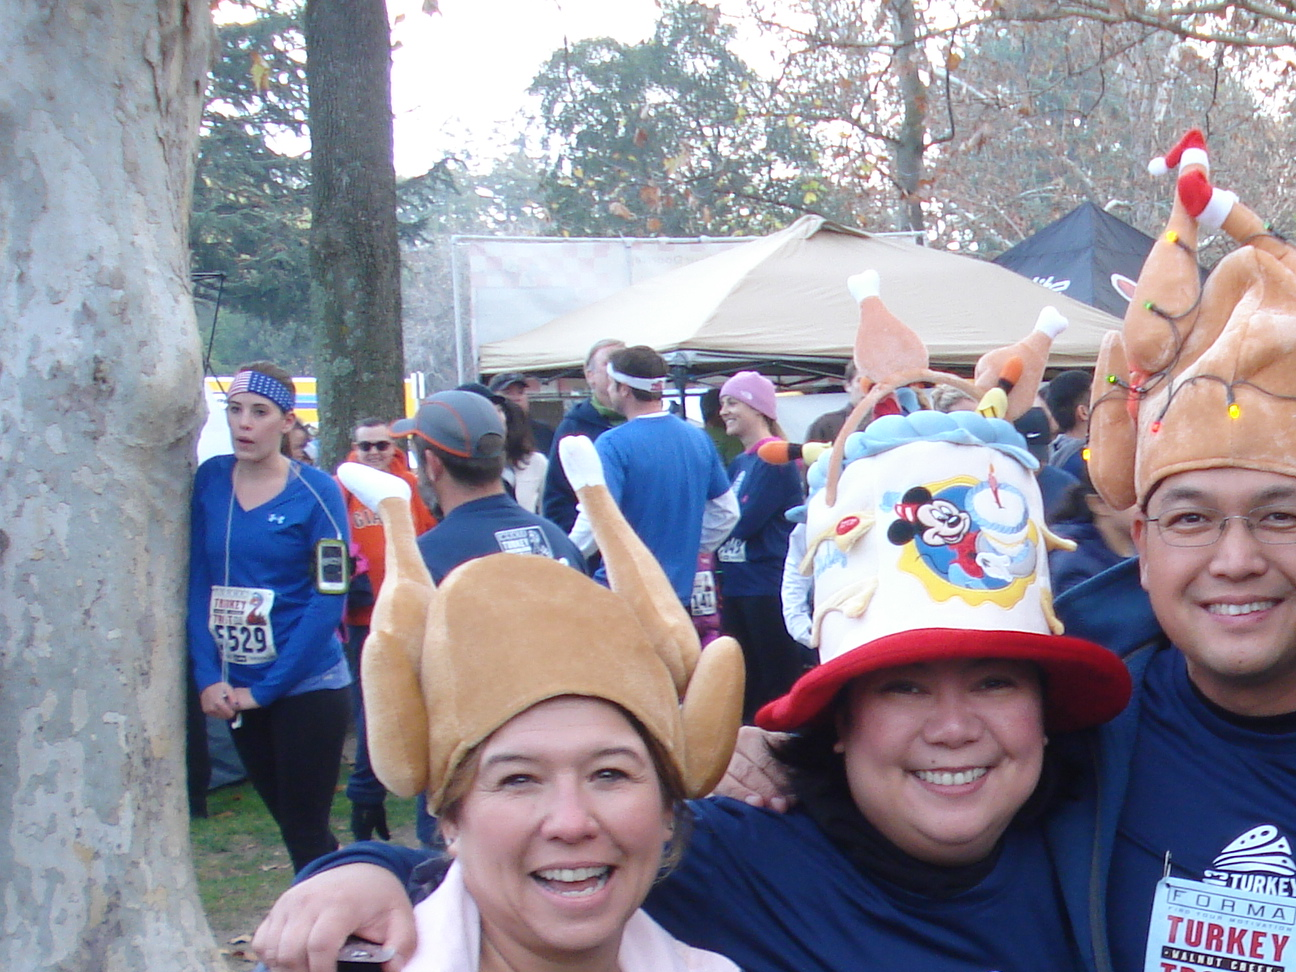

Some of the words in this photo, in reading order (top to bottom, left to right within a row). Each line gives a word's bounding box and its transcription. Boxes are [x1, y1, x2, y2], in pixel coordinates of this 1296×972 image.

[214, 624, 268, 653] 5529
[1172, 889, 1287, 921] FORMA
[1167, 914, 1290, 963] TURKEY
[1171, 949, 1223, 968] WALNUT
